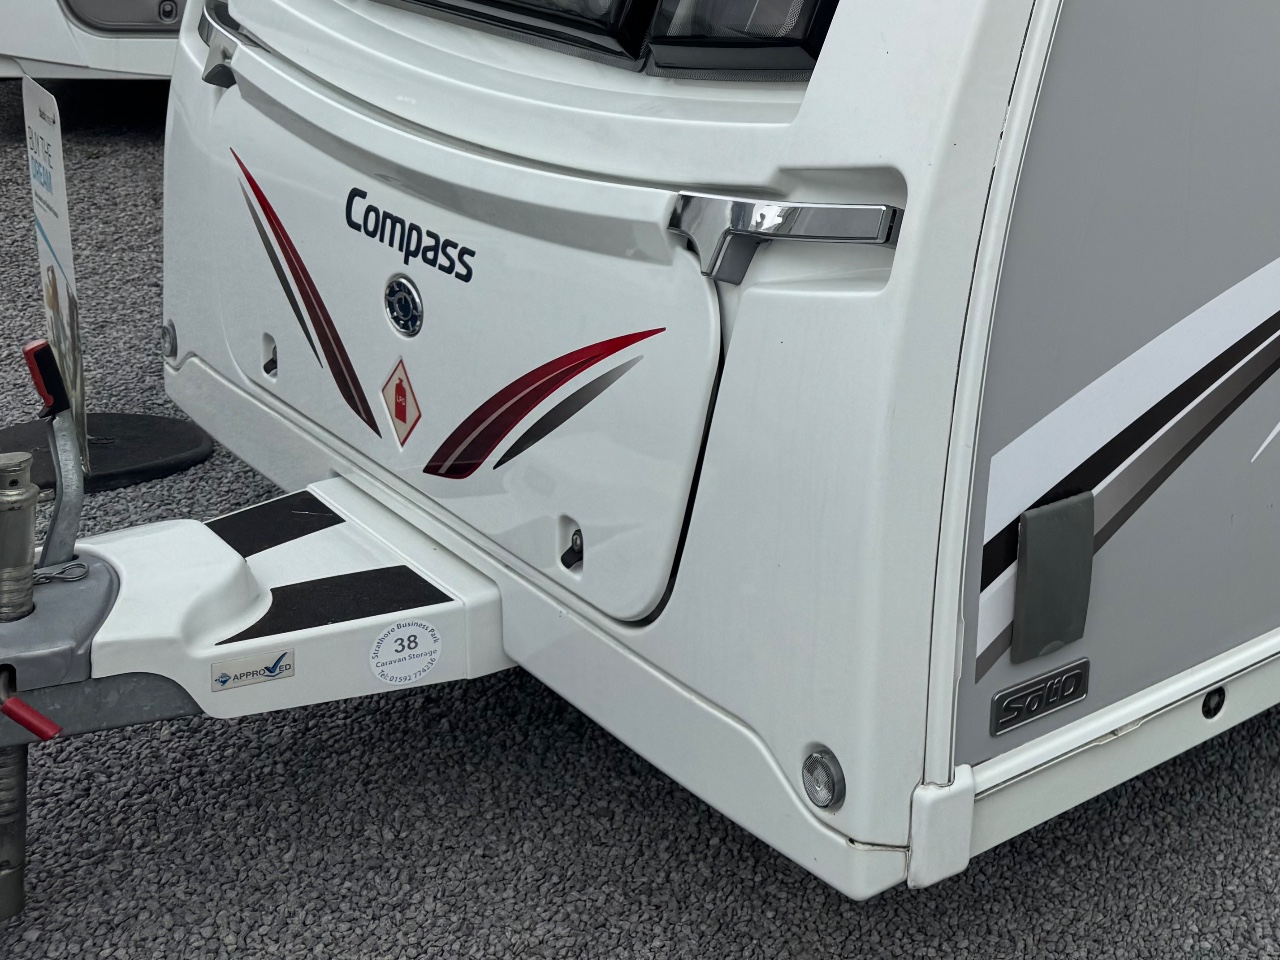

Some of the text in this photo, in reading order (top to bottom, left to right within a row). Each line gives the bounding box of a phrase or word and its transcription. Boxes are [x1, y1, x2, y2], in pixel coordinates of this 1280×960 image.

[345, 187, 477, 283] Compass
[371, 621, 440, 660] Strathore Business Park
[394, 634, 419, 653] 38
[375, 649, 438, 668] Caravan Storage
